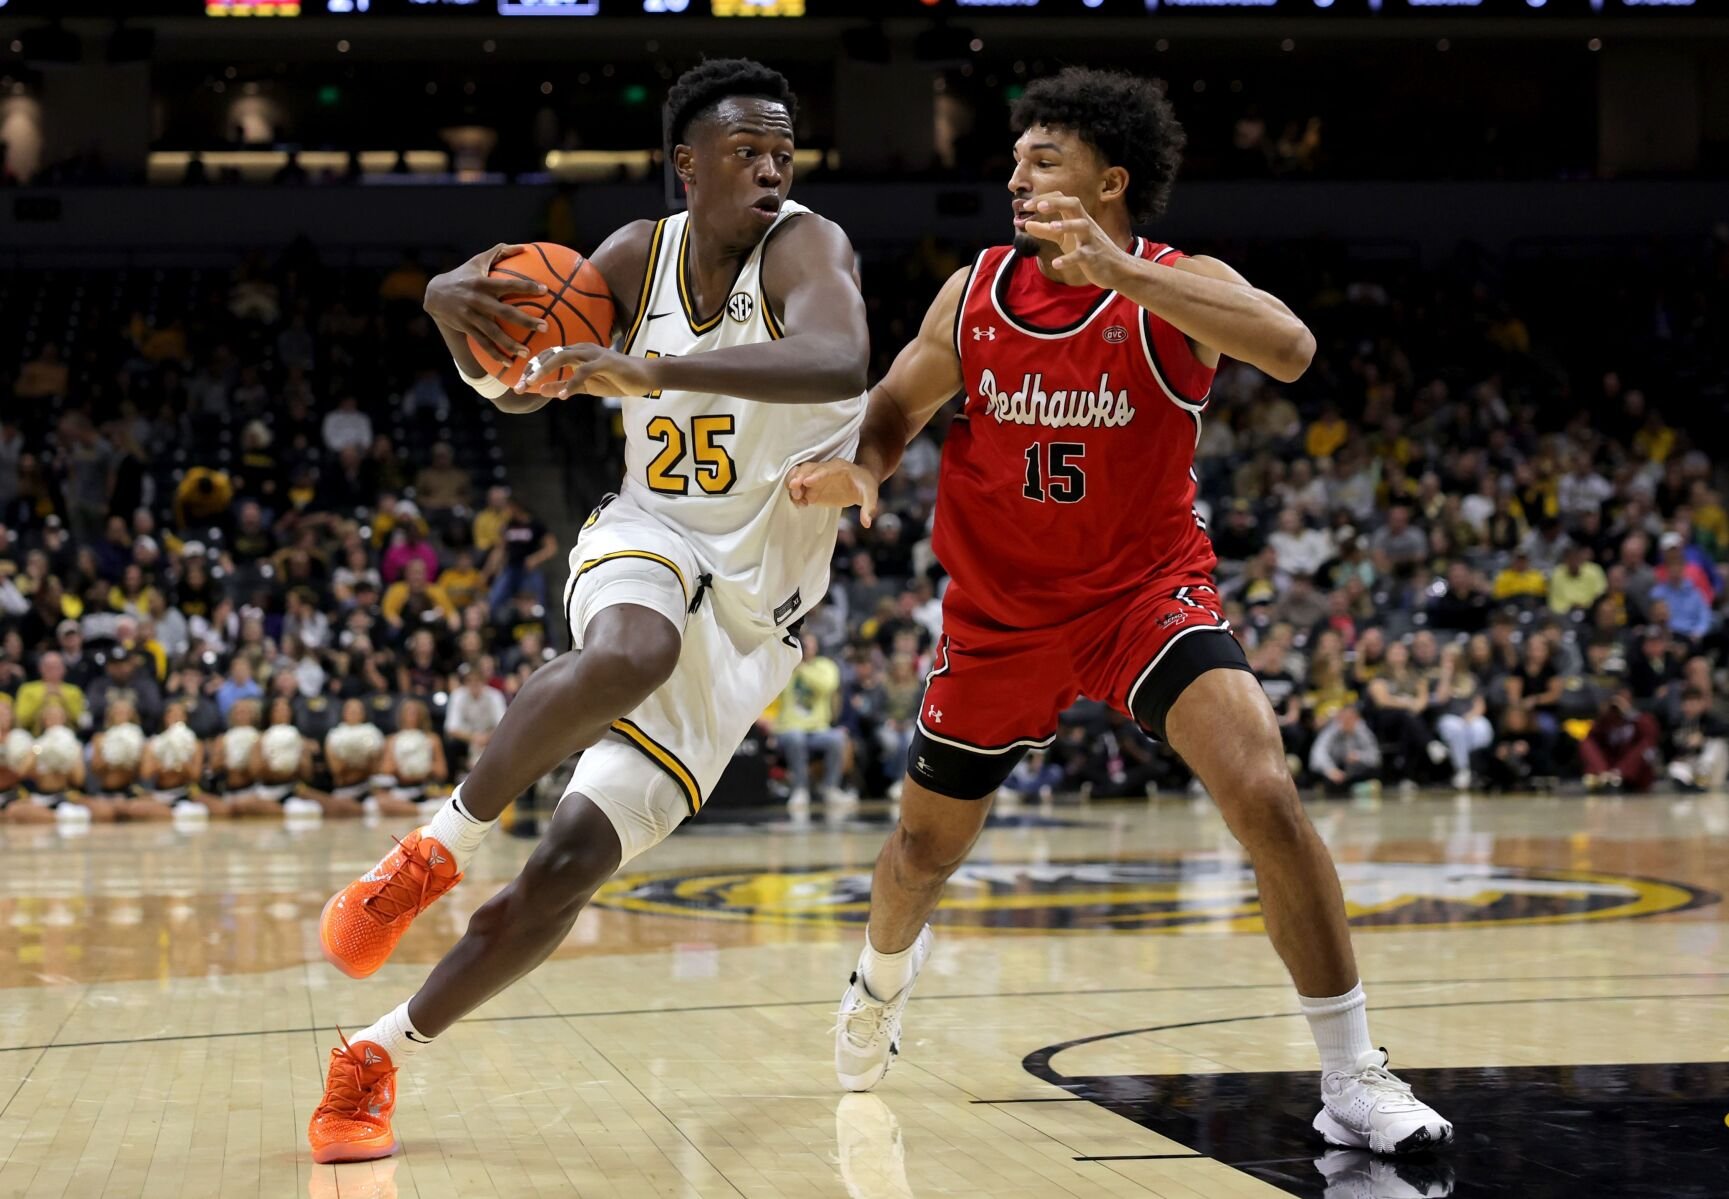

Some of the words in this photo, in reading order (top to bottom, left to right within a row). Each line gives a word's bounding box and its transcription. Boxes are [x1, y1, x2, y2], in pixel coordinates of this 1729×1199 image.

[728, 293, 752, 322] SEC
[978, 367, 1136, 430] Redhawks
[646, 414, 737, 495] 25
[1022, 441, 1086, 504] 15
